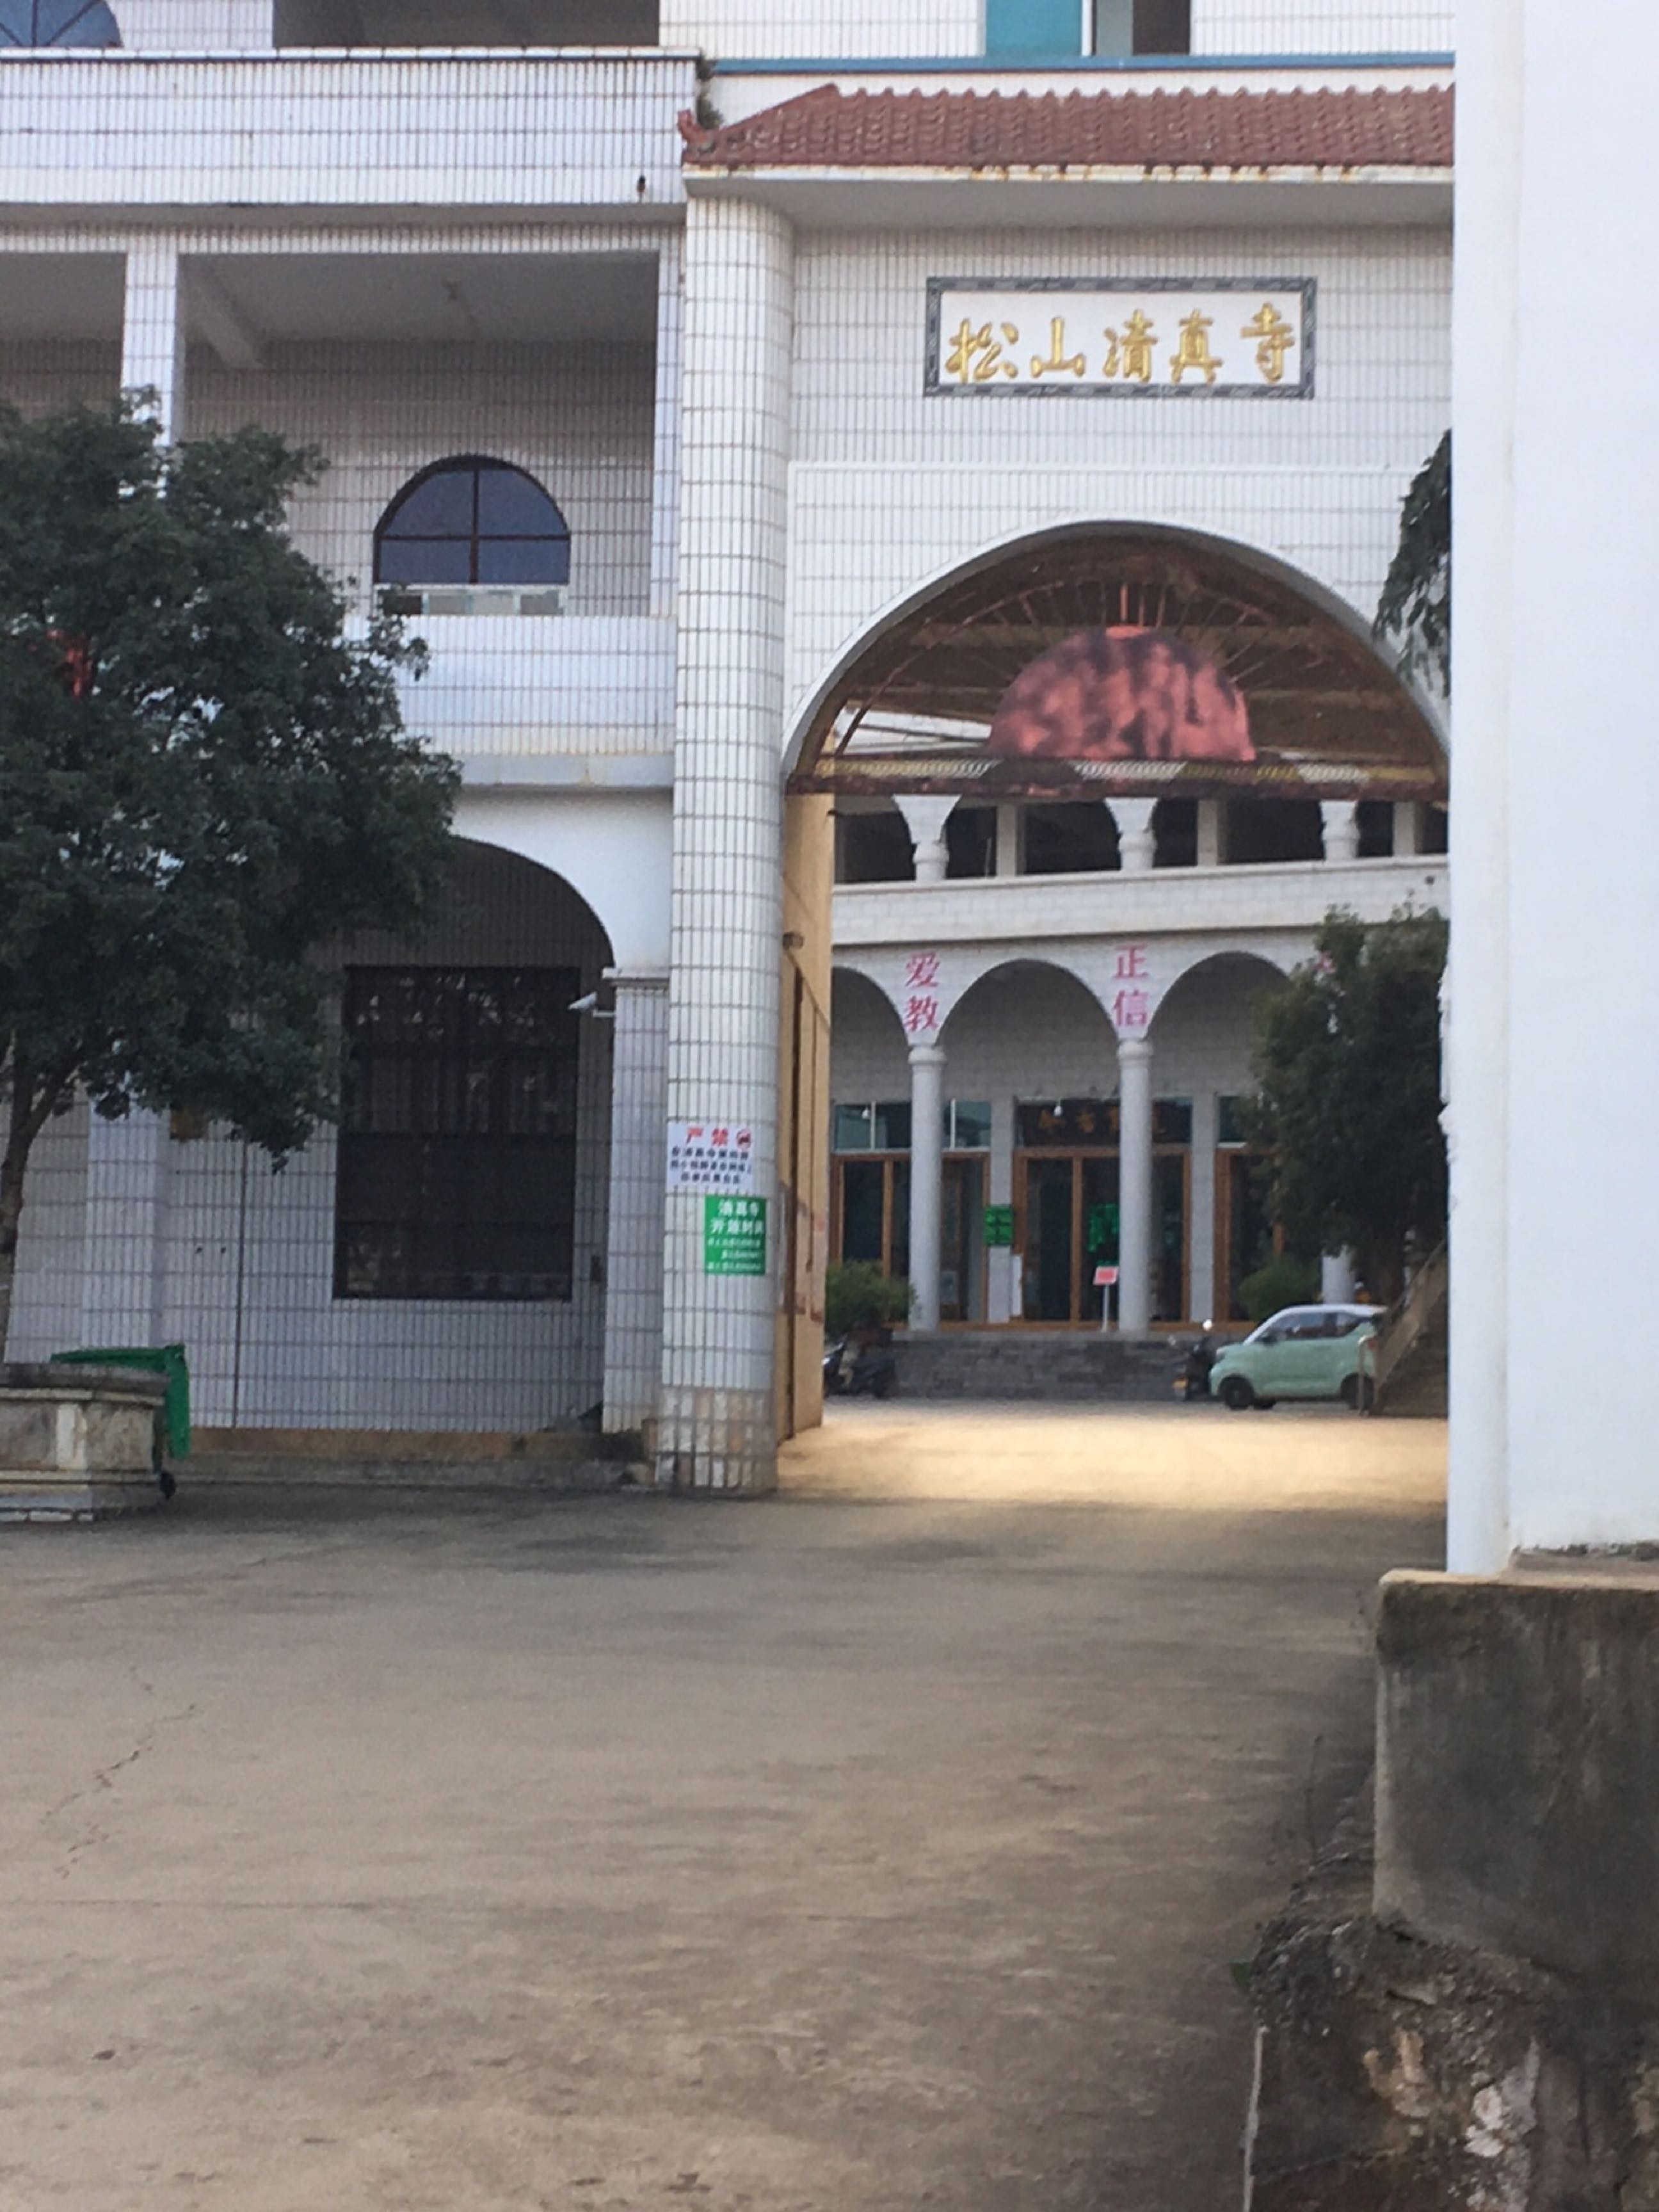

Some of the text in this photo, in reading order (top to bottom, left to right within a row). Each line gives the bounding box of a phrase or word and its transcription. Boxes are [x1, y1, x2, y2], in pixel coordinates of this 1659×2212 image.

[945, 302, 1294, 384] 松山清真寺
[906, 952, 940, 1032] 爱教
[1114, 945, 1148, 1026] 正信
